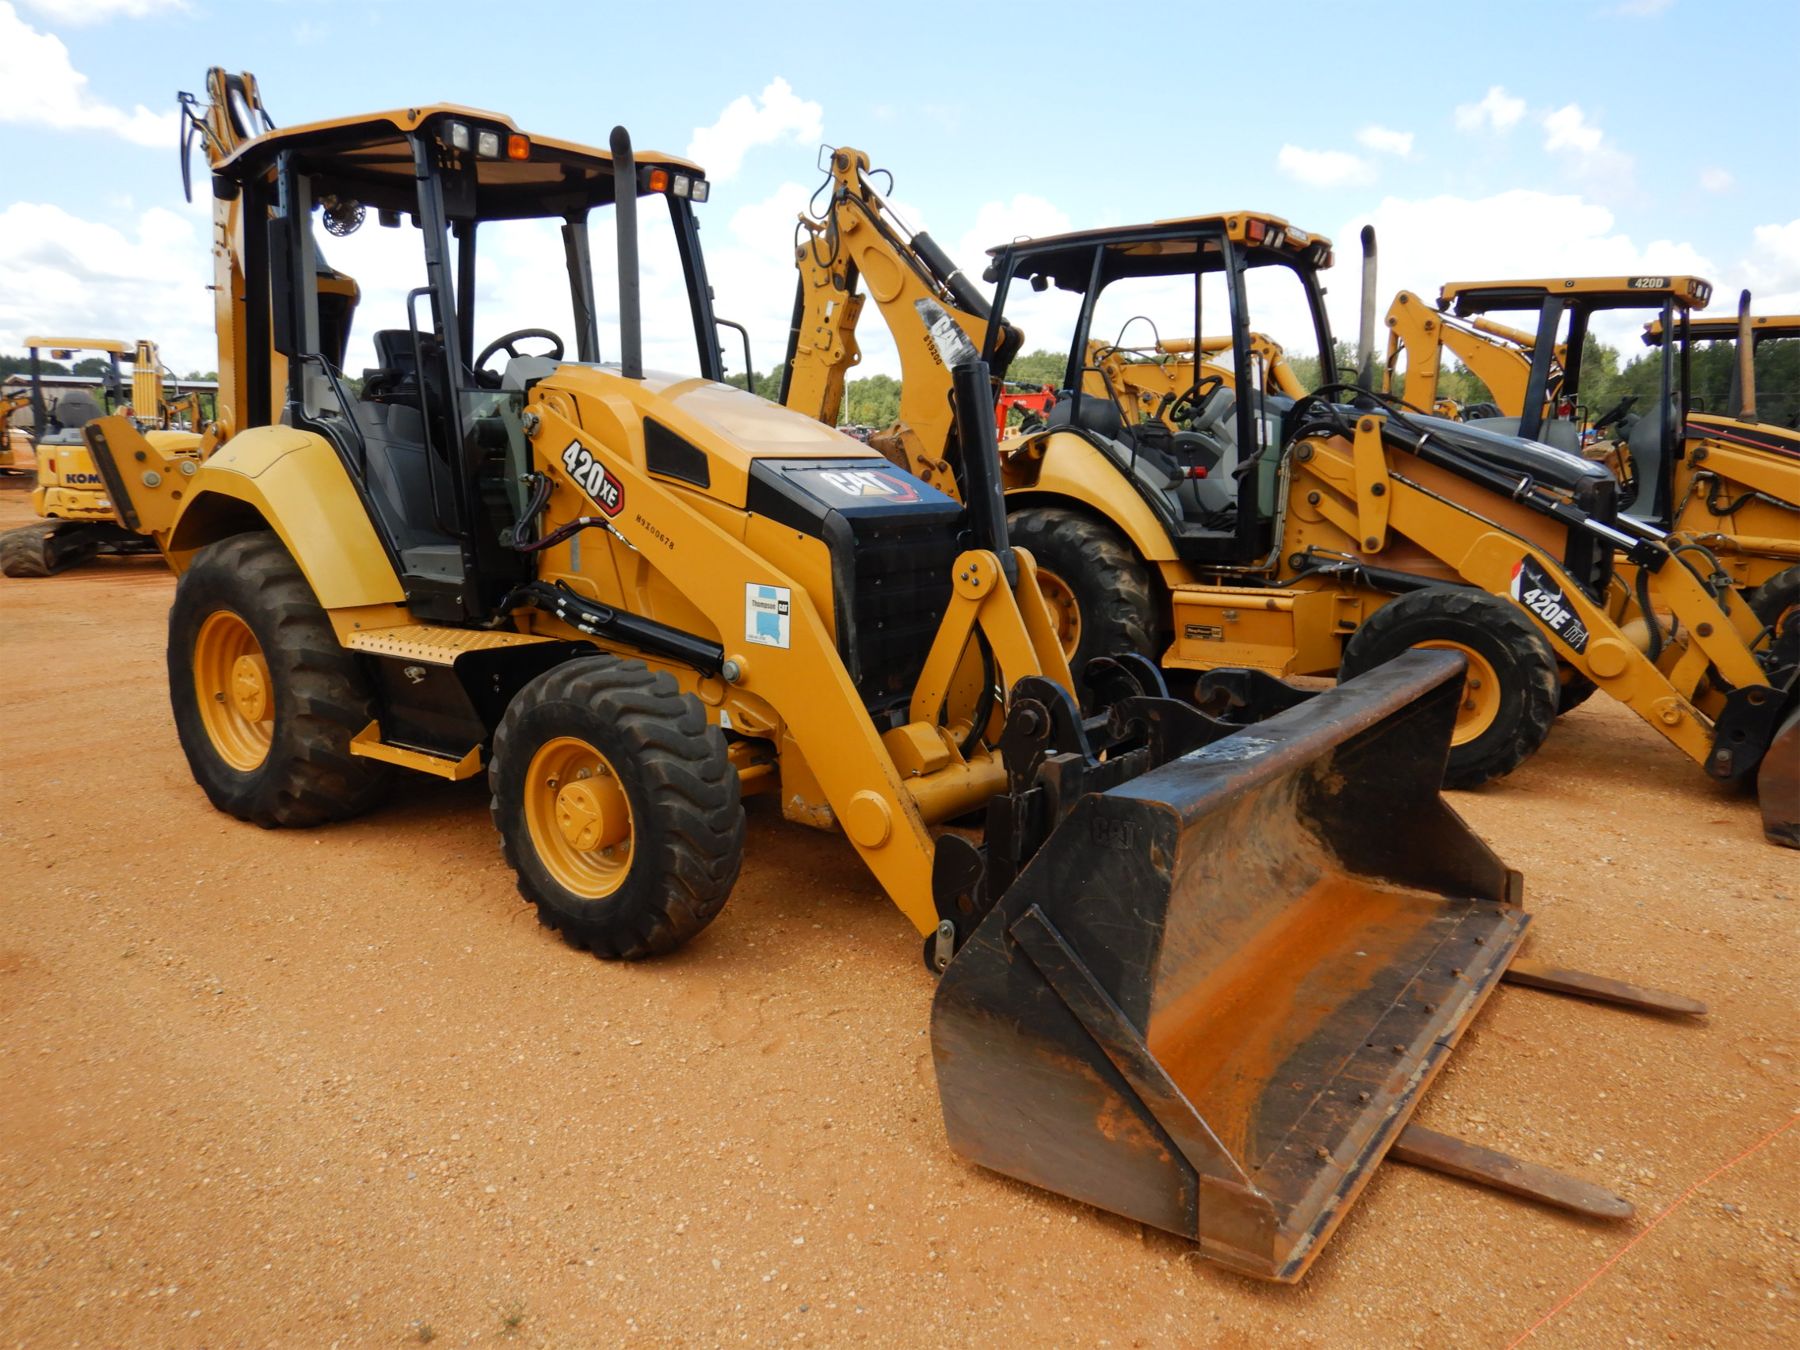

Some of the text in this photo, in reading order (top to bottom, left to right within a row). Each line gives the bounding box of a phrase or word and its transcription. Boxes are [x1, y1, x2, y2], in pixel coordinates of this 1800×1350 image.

[1634, 277, 1665, 289] 420D
[931, 314, 965, 361] CAT
[562, 439, 619, 508] 420XE
[819, 471, 899, 497] CAT
[1522, 588, 1572, 630] 420E
